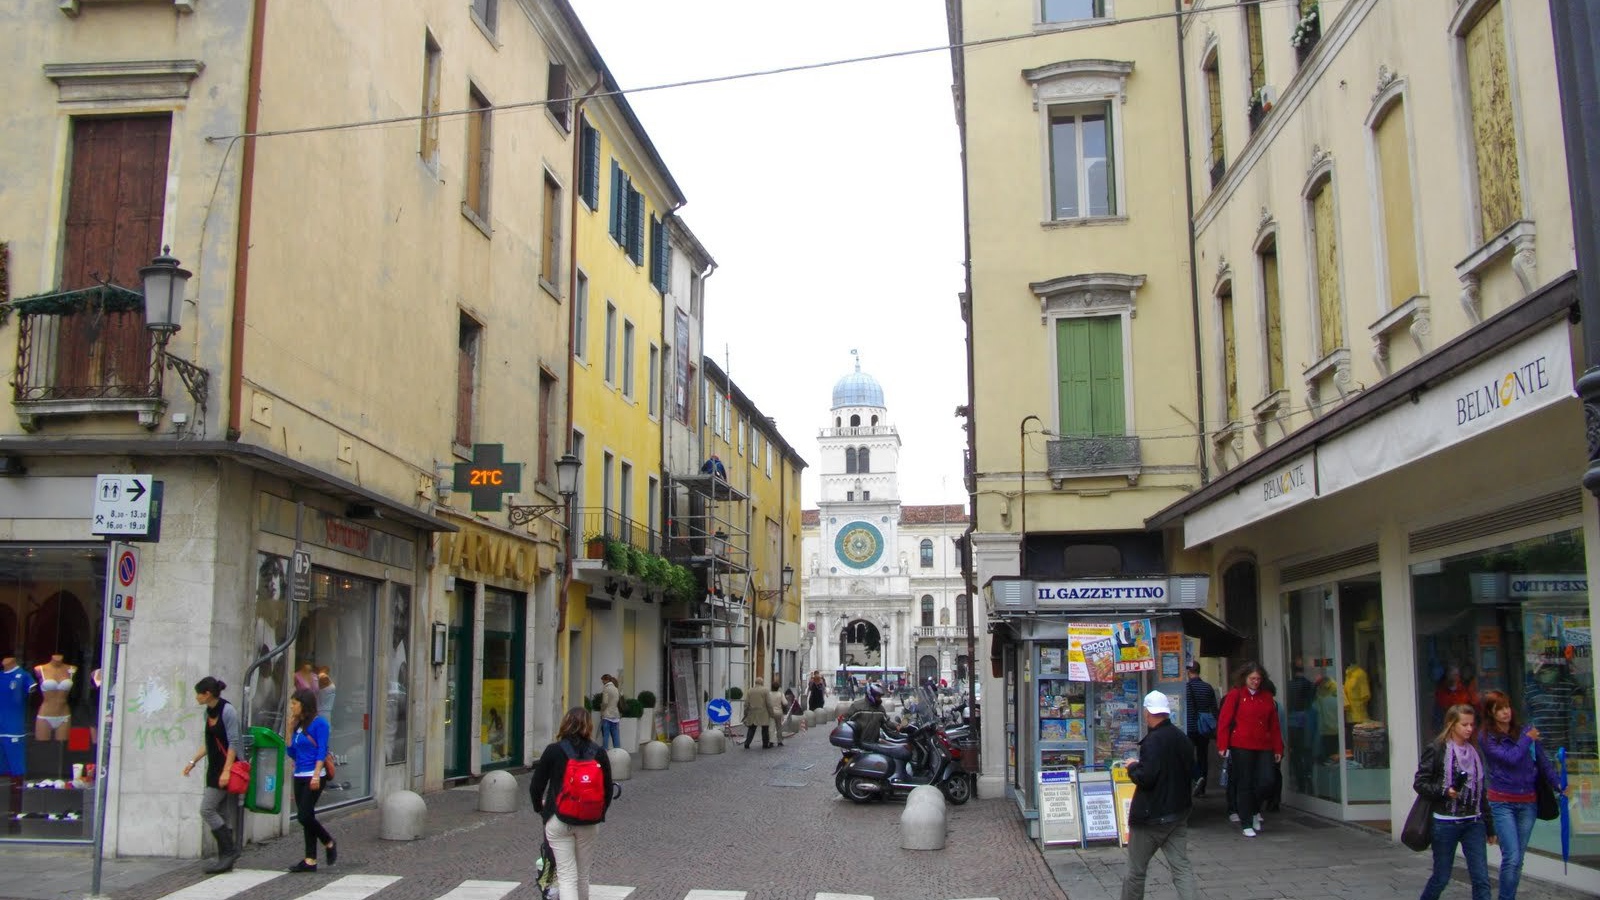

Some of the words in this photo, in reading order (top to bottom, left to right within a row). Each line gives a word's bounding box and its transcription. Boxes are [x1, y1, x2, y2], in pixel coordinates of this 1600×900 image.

[1456, 356, 1550, 427] BELMONTE
[470, 470, 502, 485] 21°C
[1263, 464, 1306, 502] BELMONTE
[130, 510, 147, 518] 13.30
[106, 521, 123, 530] 16.00
[129, 521, 146, 530] 19.30
[1038, 588, 1055, 600] IL
[1057, 587, 1164, 599] GAZZETTINO
